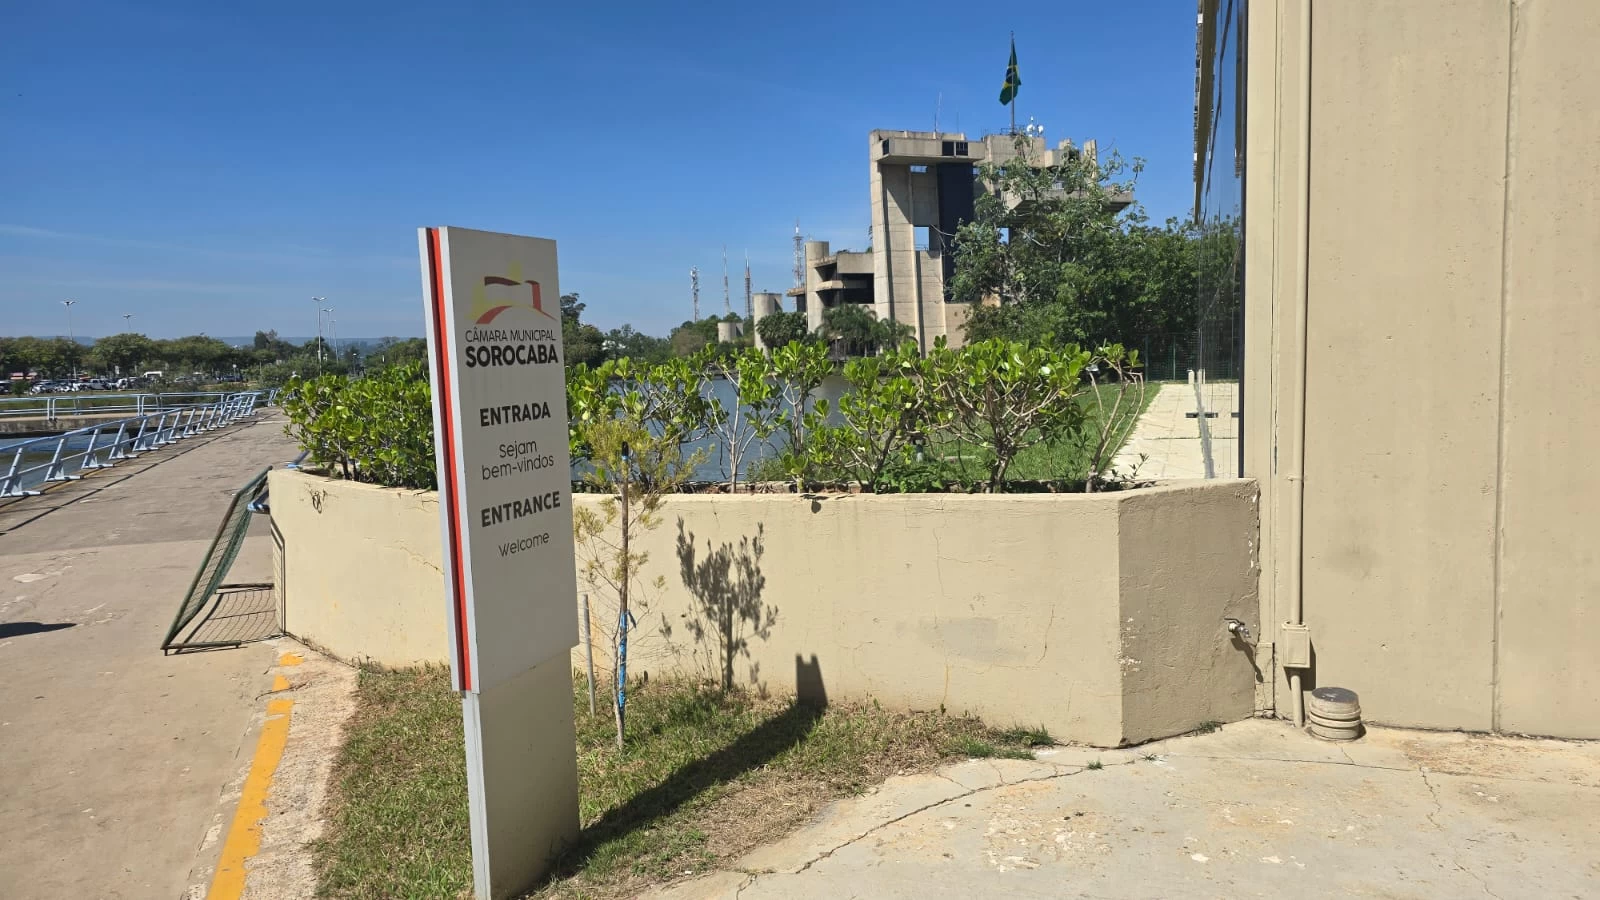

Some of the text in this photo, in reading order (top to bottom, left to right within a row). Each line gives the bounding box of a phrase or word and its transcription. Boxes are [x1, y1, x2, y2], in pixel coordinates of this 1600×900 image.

[465, 326, 557, 342] CÂMARA MUNICIPAL
[465, 344, 559, 368] SOROCABA
[479, 401, 551, 427] ENTRADA
[499, 440, 538, 459] Sejam
[482, 454, 554, 480] bem-vindos
[480, 491, 561, 527] ENTRANCE
[498, 532, 550, 557] Welcome
